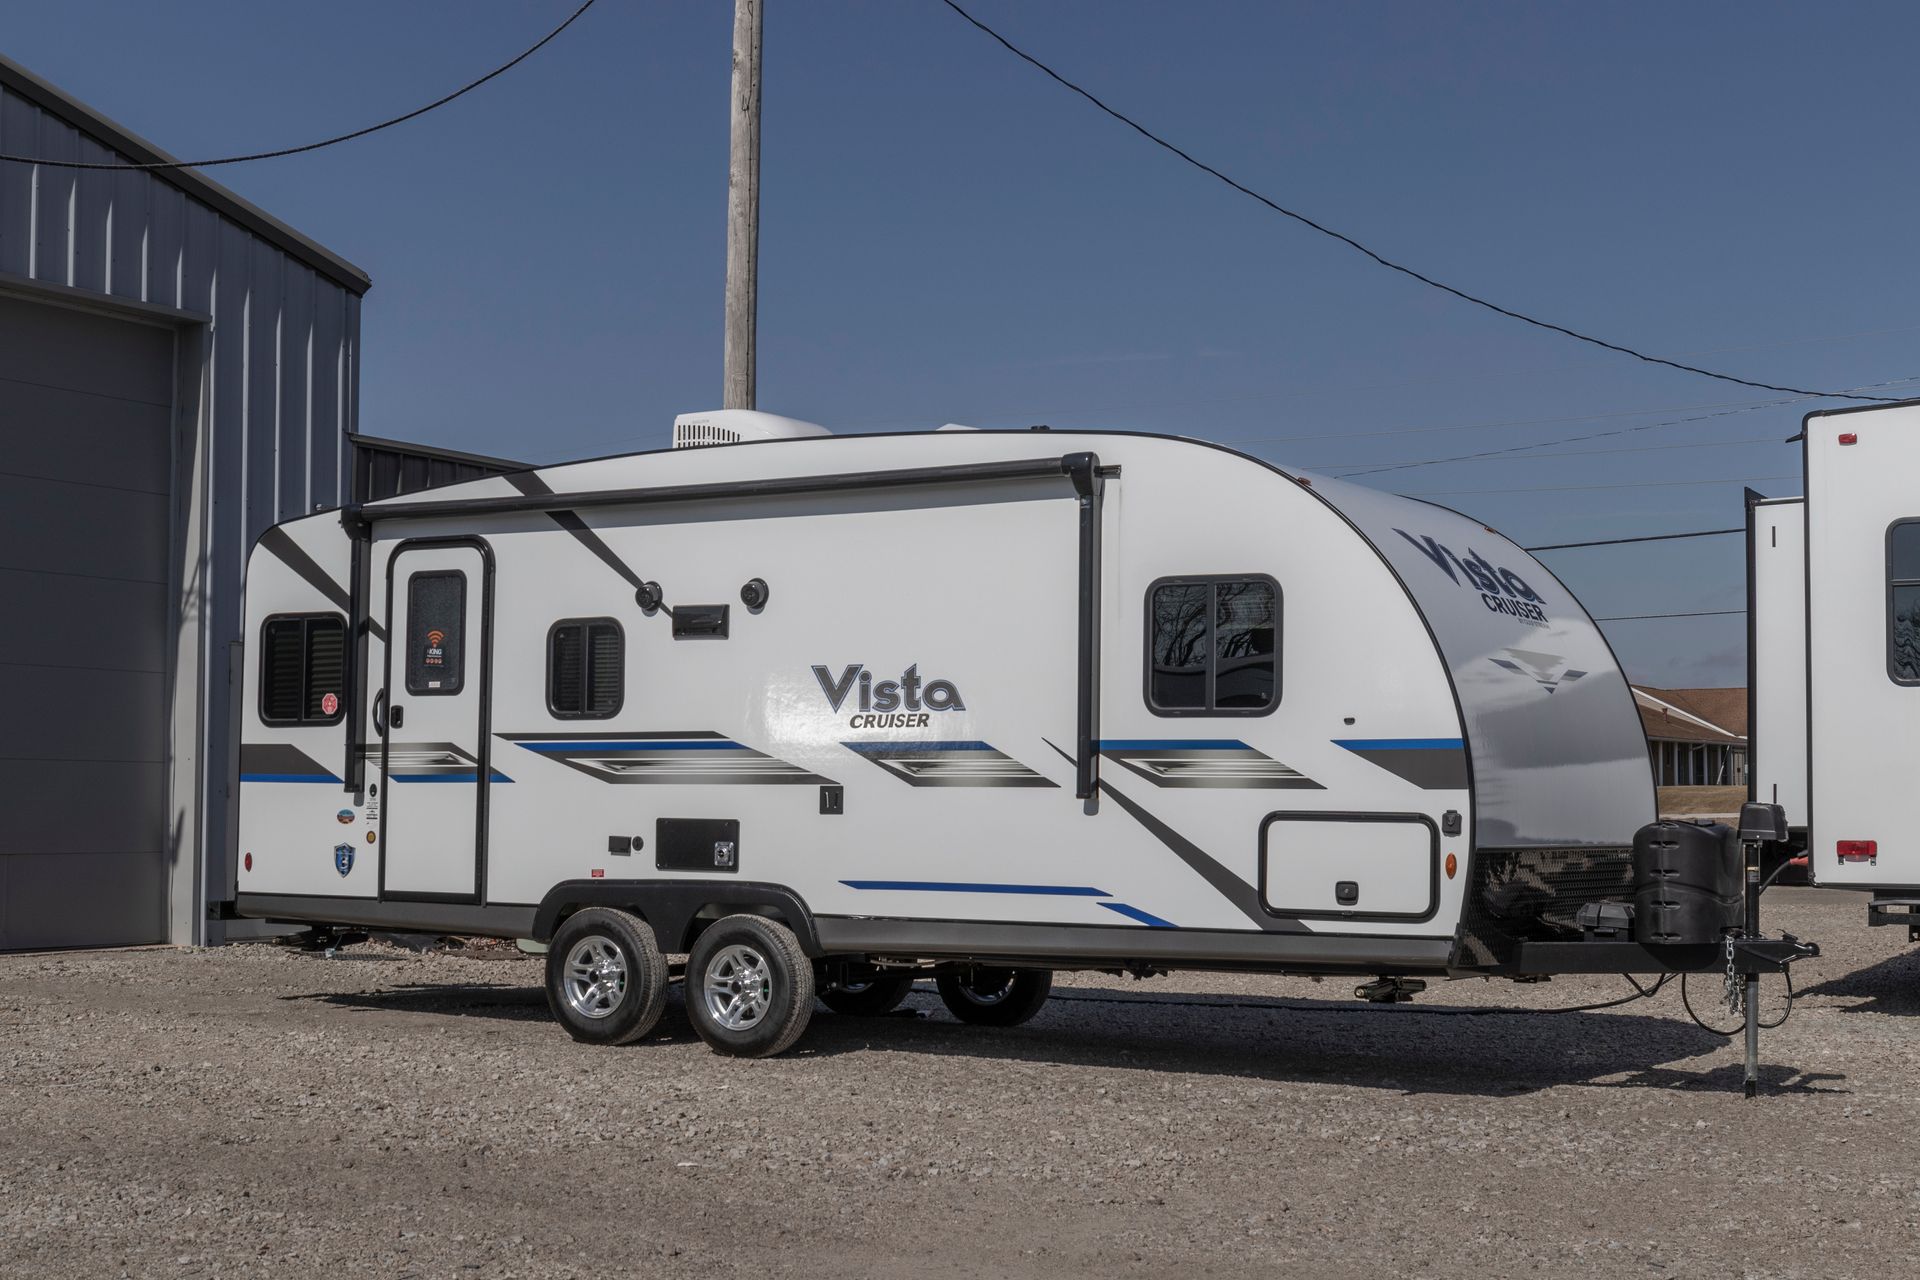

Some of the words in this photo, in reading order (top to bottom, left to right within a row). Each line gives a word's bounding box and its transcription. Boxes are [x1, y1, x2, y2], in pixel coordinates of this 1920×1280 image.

[1392, 528, 1547, 605] Vista
[1481, 593, 1549, 622] CRUISER
[811, 663, 966, 714] Vista
[849, 713, 930, 728] CRUISER
